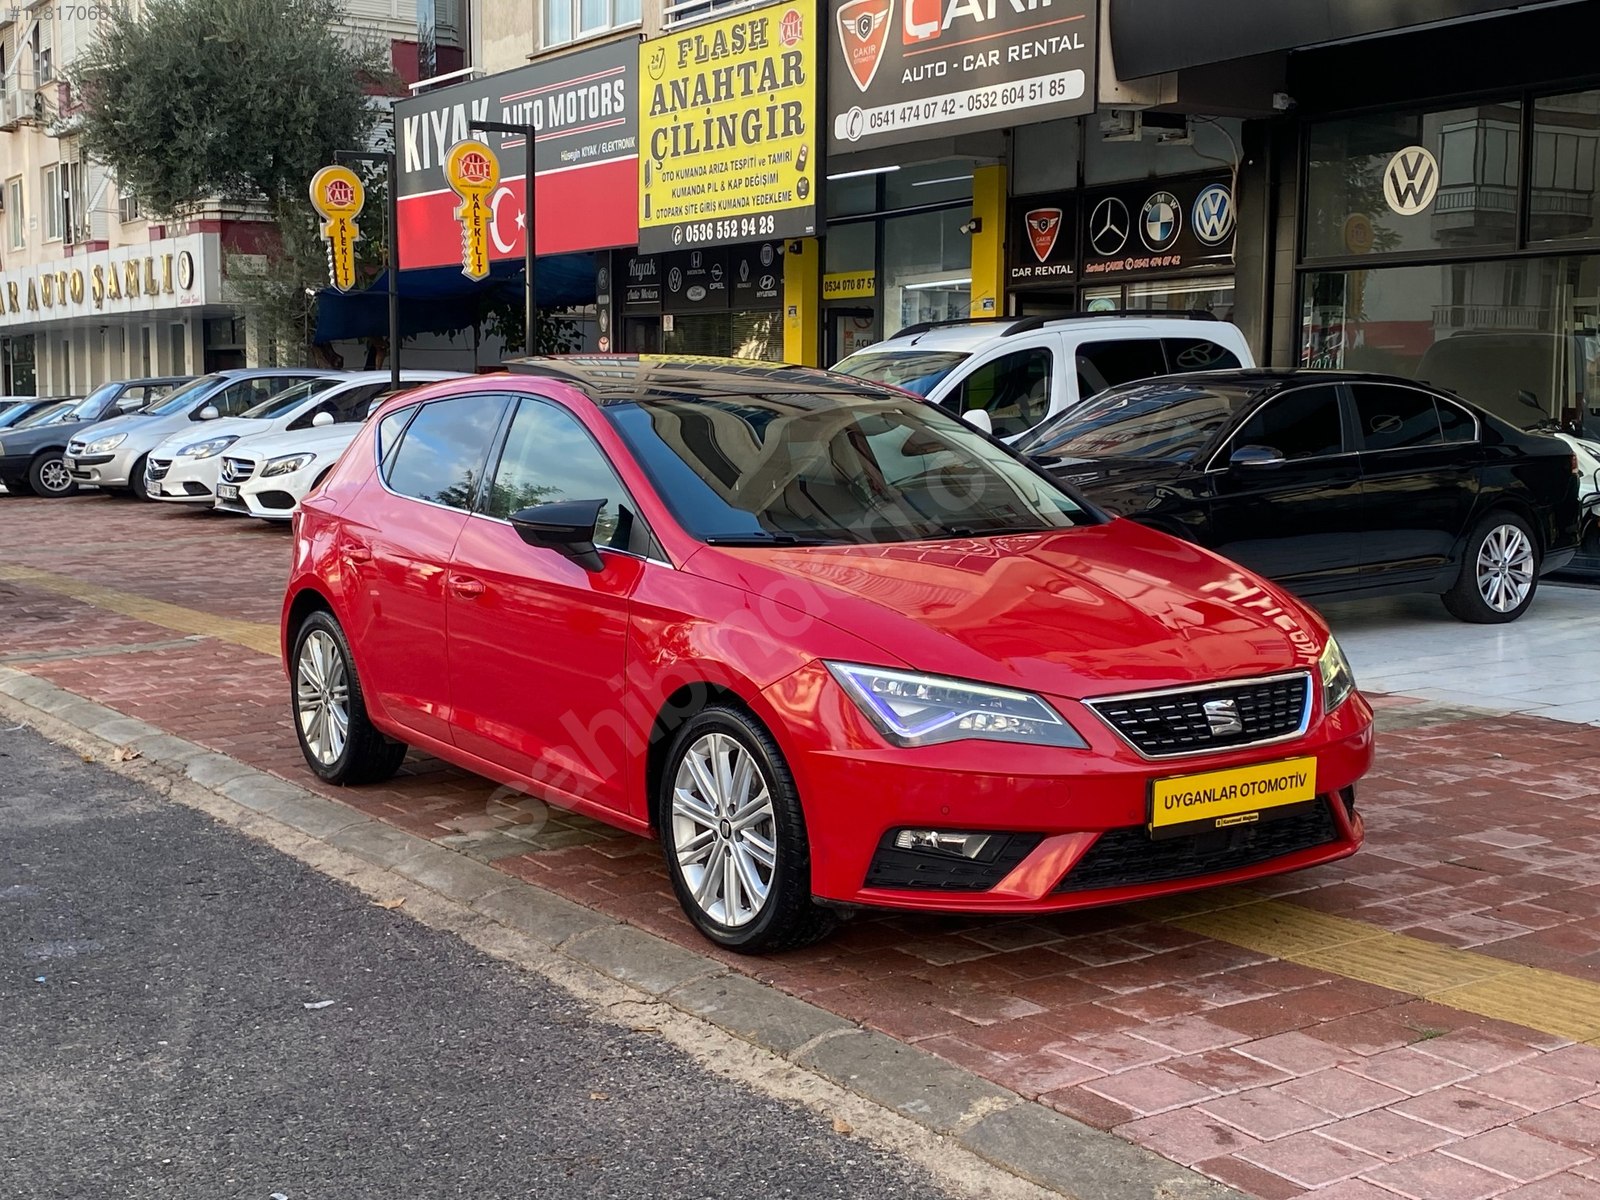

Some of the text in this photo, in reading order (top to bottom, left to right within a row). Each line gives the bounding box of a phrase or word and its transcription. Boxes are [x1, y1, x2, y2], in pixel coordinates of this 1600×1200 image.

[677, 17, 769, 69] FLASH
[779, 16, 804, 44] KALE
[901, 60, 947, 84] AUTO
[962, 49, 1000, 72] CAR
[1008, 32, 1085, 63] RENTAL
[649, 50, 805, 117] ANAHTAR
[501, 98, 544, 139] AUTO
[548, 78, 625, 128] MOTORS
[870, 107, 896, 129] 0541
[899, 103, 921, 123] 474
[923, 101, 938, 120] 07
[941, 98, 956, 116] 42
[967, 90, 998, 112] 0532
[1001, 85, 1025, 106] 604
[1028, 81, 1044, 100] 51
[1049, 77, 1066, 97] 85
[650, 94, 806, 170] ÇİLİNGİR
[460, 160, 491, 178] KALE
[662, 171, 674, 182] OTO
[675, 166, 707, 180] KUMANDA
[708, 161, 728, 175] ARIZA
[758, 158, 767, 167] ve
[326, 187, 354, 202] KALE
[671, 184, 705, 198] KUMANDA
[727, 177, 743, 190] KAP
[656, 205, 682, 219] OTOPARK
[718, 196, 750, 211] KUMANDA
[751, 190, 792, 206] YEDEKLEME
[685, 214, 775, 243] 0536 552 94 28
[824, 280, 841, 292] 0534
[842, 278, 855, 290] 070
[856, 278, 866, 290] 87
[1012, 264, 1074, 277] CAR RENTAL
[27, 268, 84, 311] AUTO
[709, 282, 725, 290] OPEL
[1163, 771, 1308, 810] UYGANLAR OTOMOTİV
